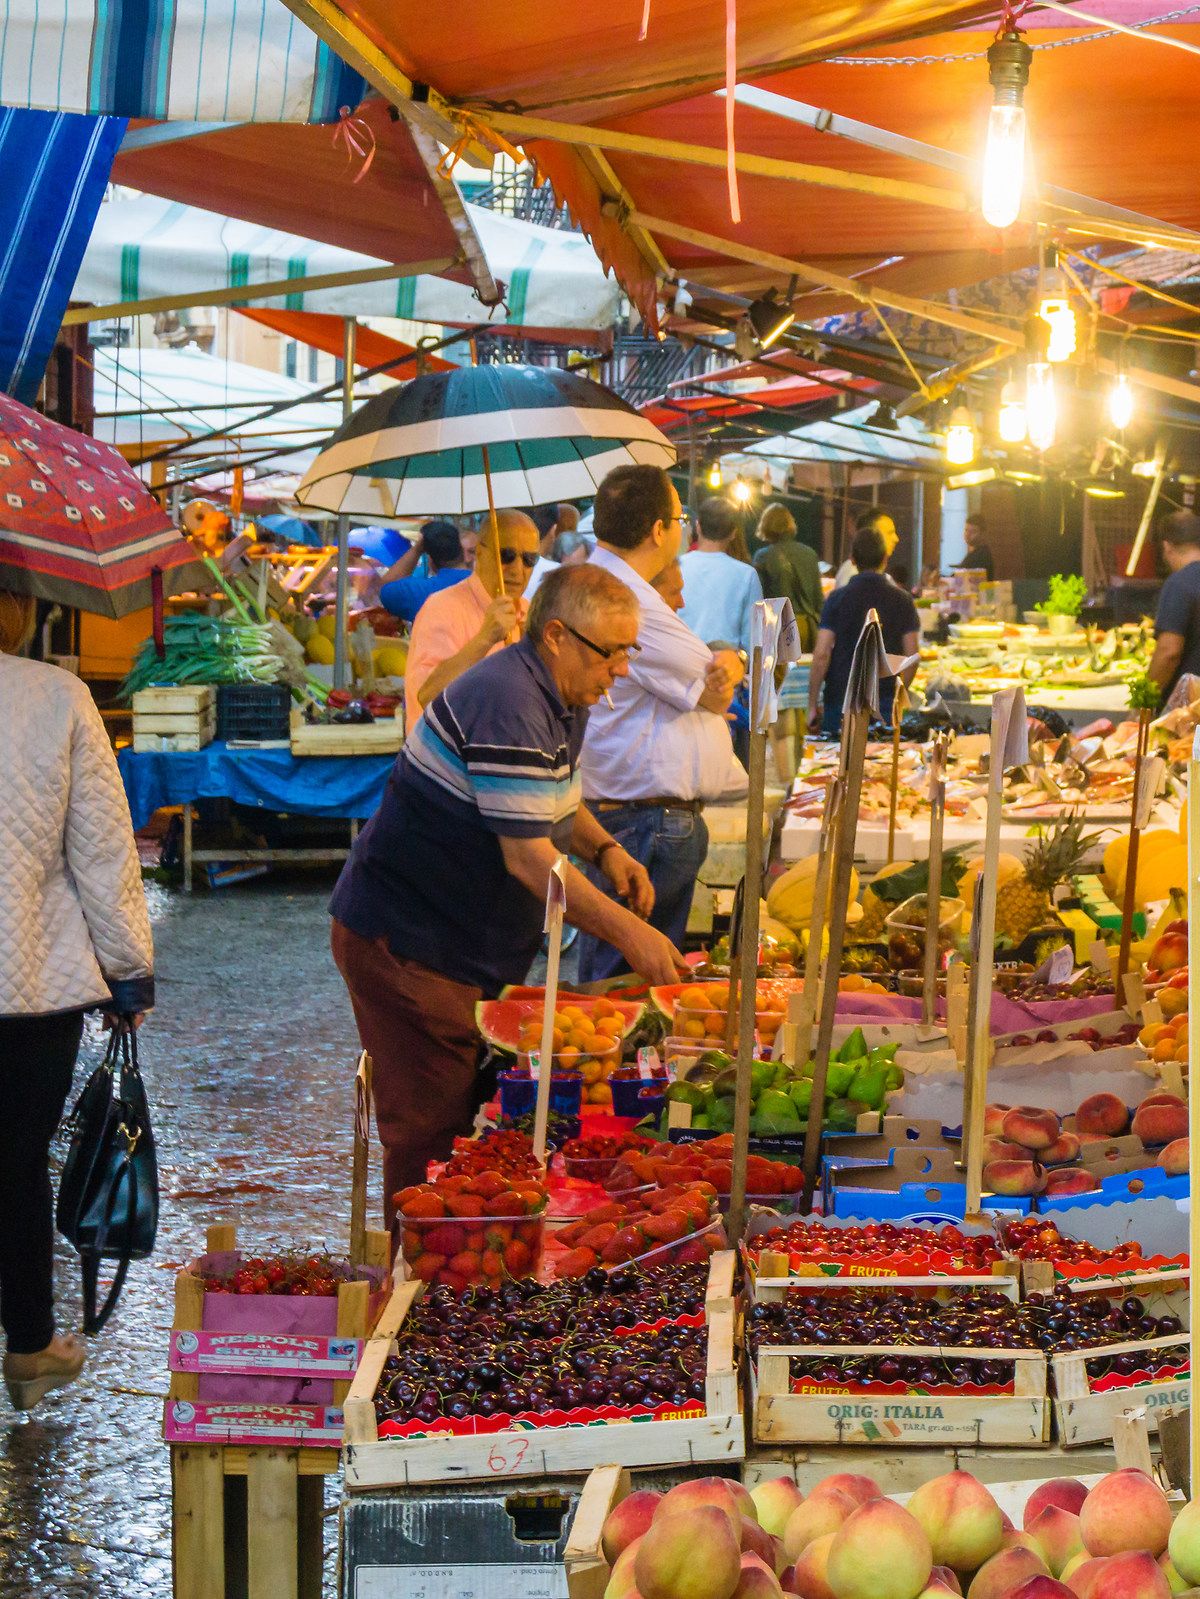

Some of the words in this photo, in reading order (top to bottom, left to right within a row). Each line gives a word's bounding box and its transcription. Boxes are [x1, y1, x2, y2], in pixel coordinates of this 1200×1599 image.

[209, 1334, 319, 1351] NESPOLE
[215, 1347, 314, 1359] SICILIA
[206, 1405, 315, 1420] NESPOLE
[827, 1405, 878, 1419] ORIG:
[883, 1405, 944, 1419] ITALIA
[211, 1416, 310, 1428] SICILIA
[902, 1423, 926, 1431] TARA
